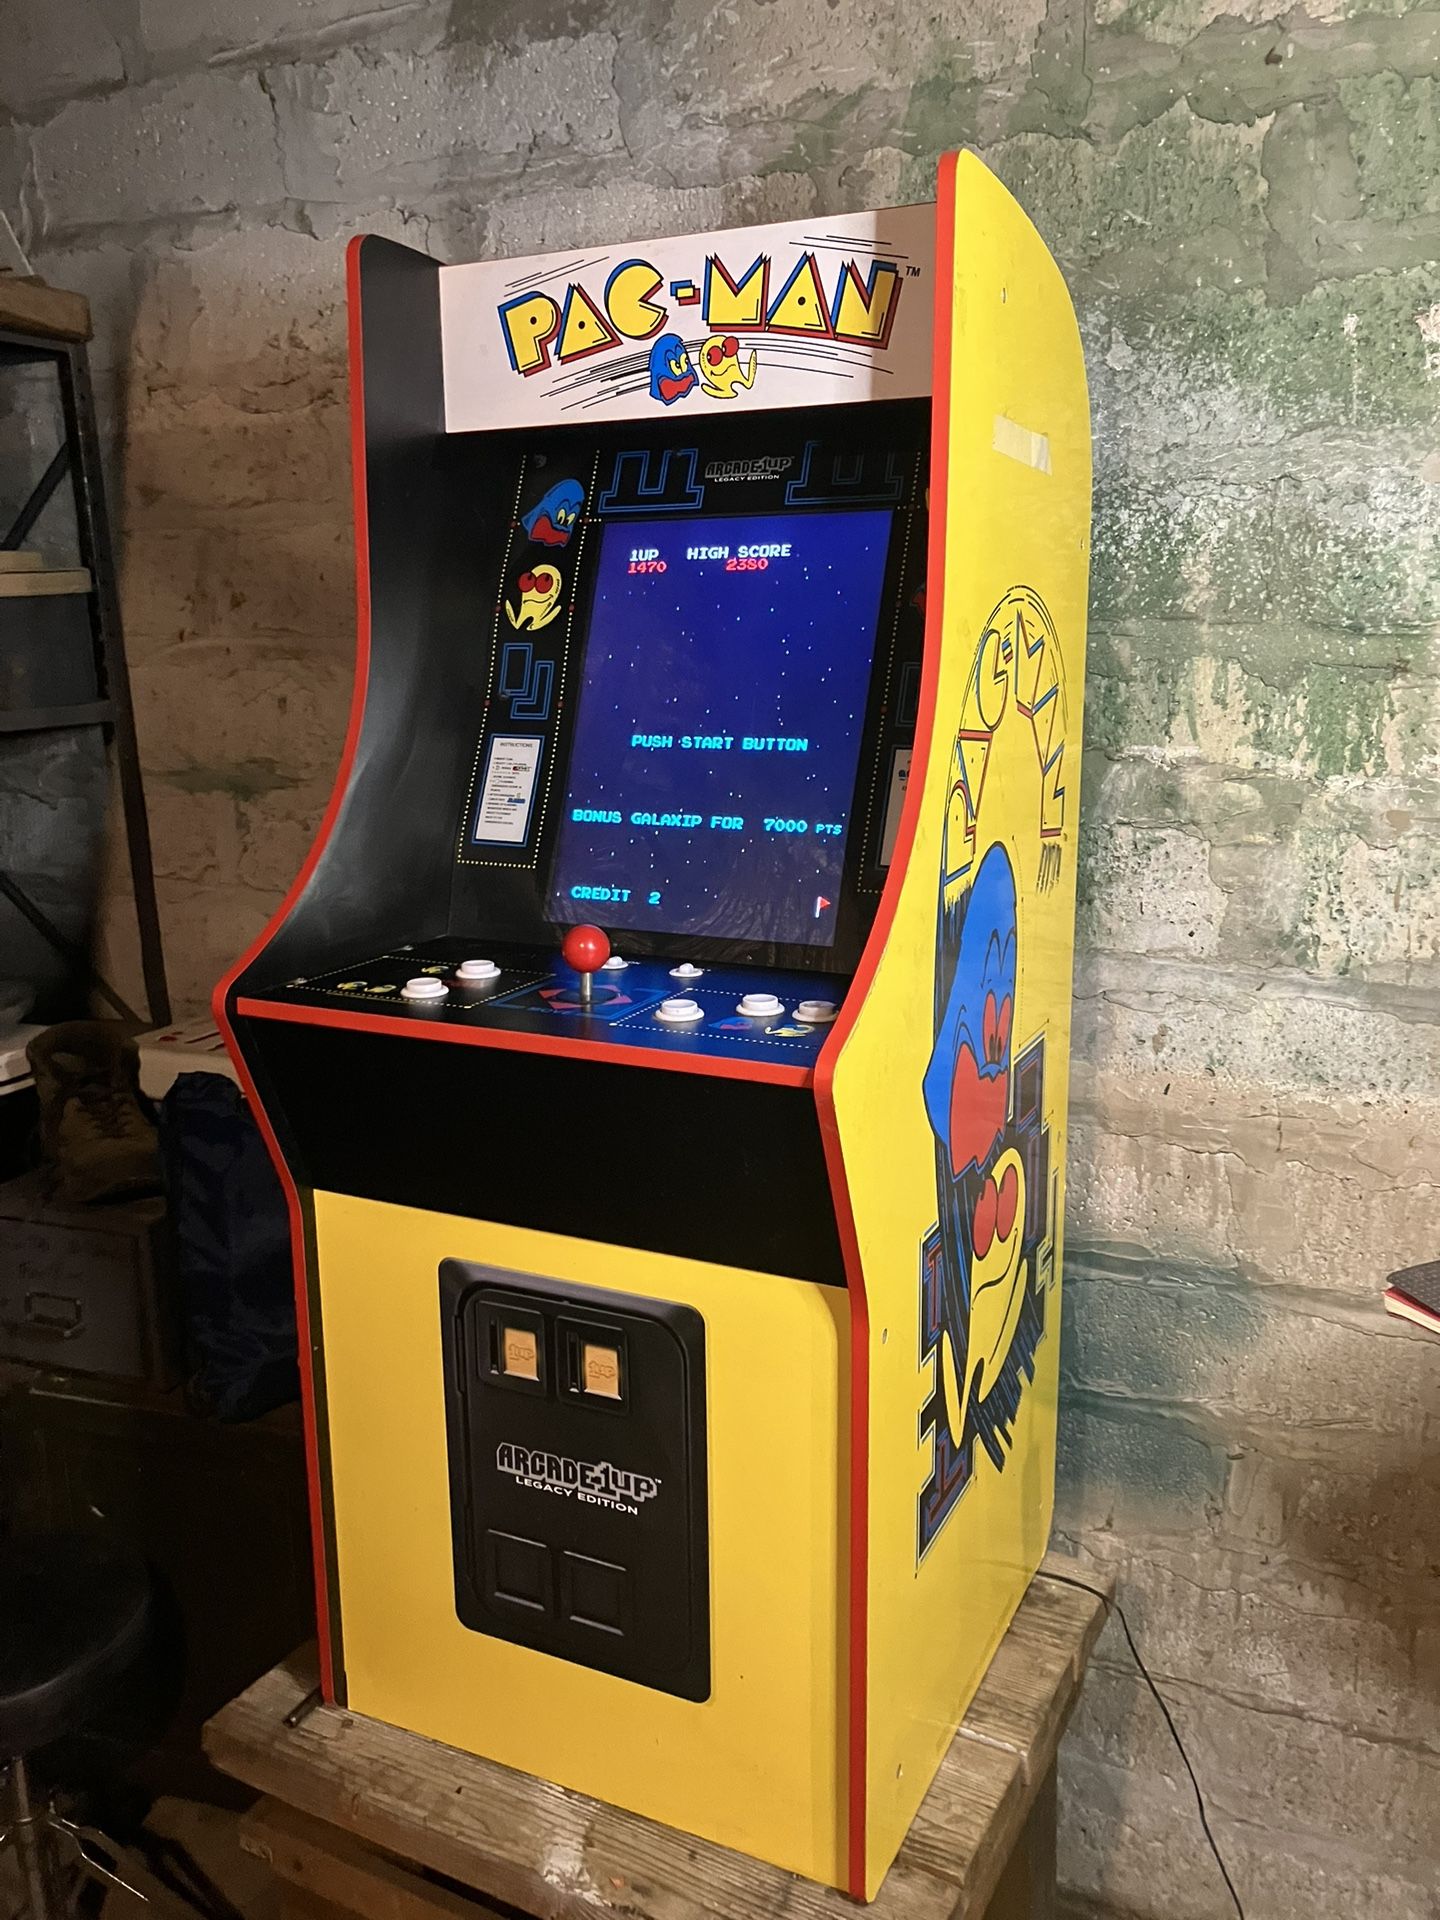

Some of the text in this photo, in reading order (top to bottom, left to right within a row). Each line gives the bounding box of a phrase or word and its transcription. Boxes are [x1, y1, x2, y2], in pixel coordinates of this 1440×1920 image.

[497, 251, 904, 377] PAC-MAN
[629, 544, 792, 562] 1UP HIGH SCORE
[628, 561, 667, 574] 1470
[631, 734, 808, 752] PUSH START BUTTON
[572, 809, 843, 835] BONUS GALAXIP FOR 7000 PTS
[571, 886, 661, 906] CREDIT 2
[515, 1475, 639, 1516] LEGACY EDITION
